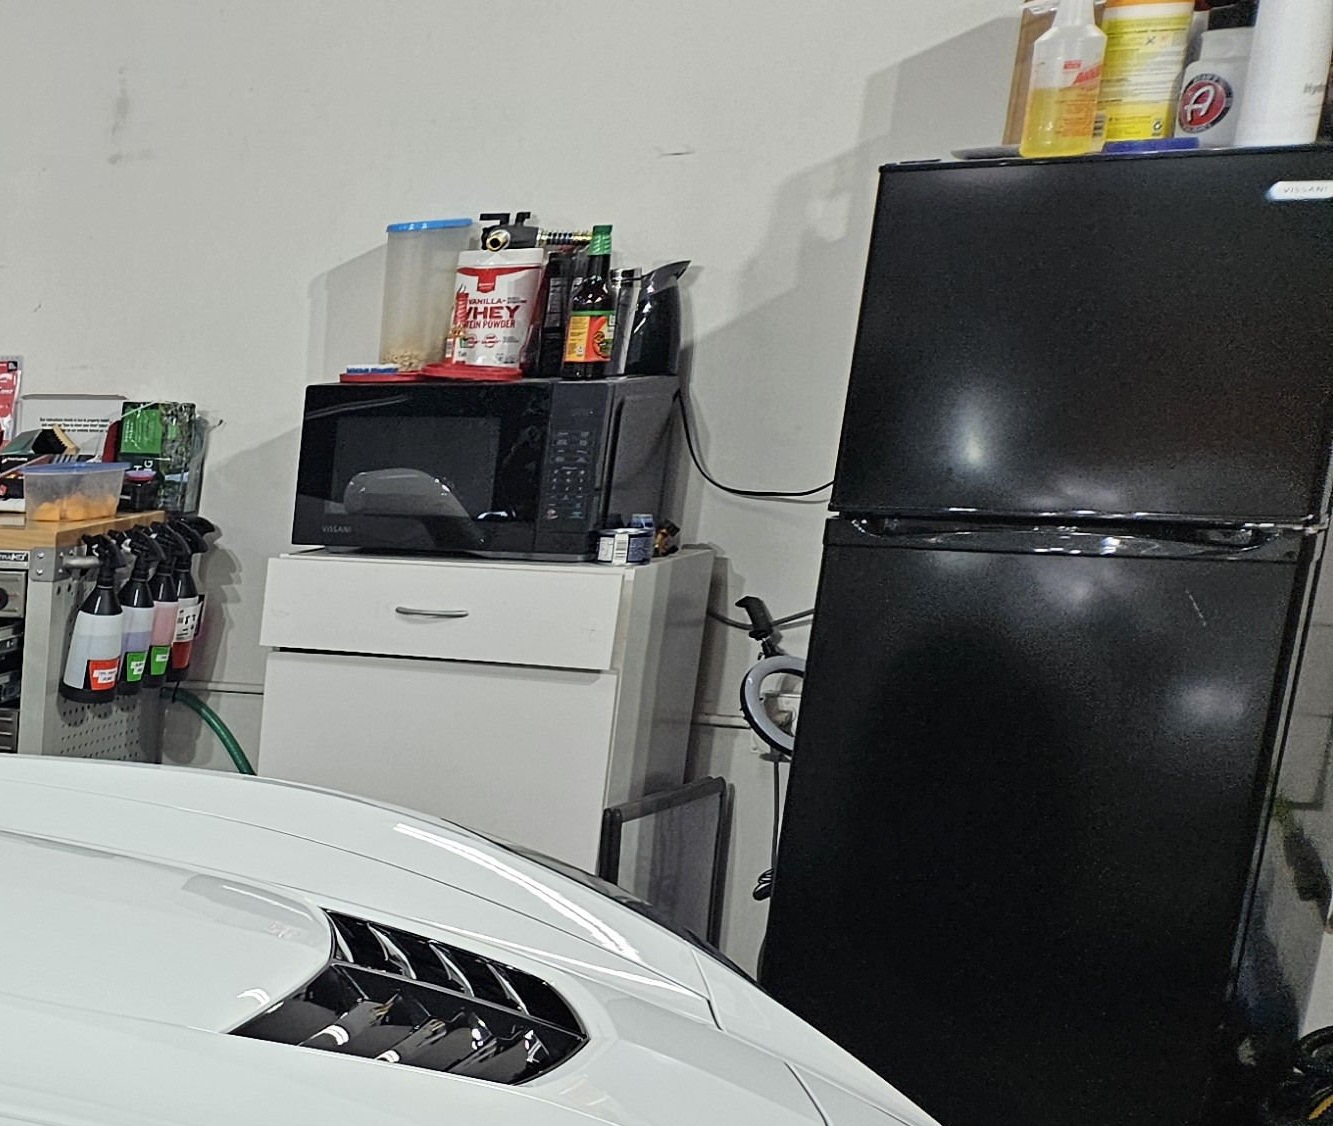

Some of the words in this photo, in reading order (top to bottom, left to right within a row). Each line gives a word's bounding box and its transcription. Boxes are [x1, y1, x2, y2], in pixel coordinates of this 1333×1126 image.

[1284, 185, 1328, 194] VISSANI
[466, 320, 481, 329] TEIN
[321, 525, 352, 533] VISSANI
